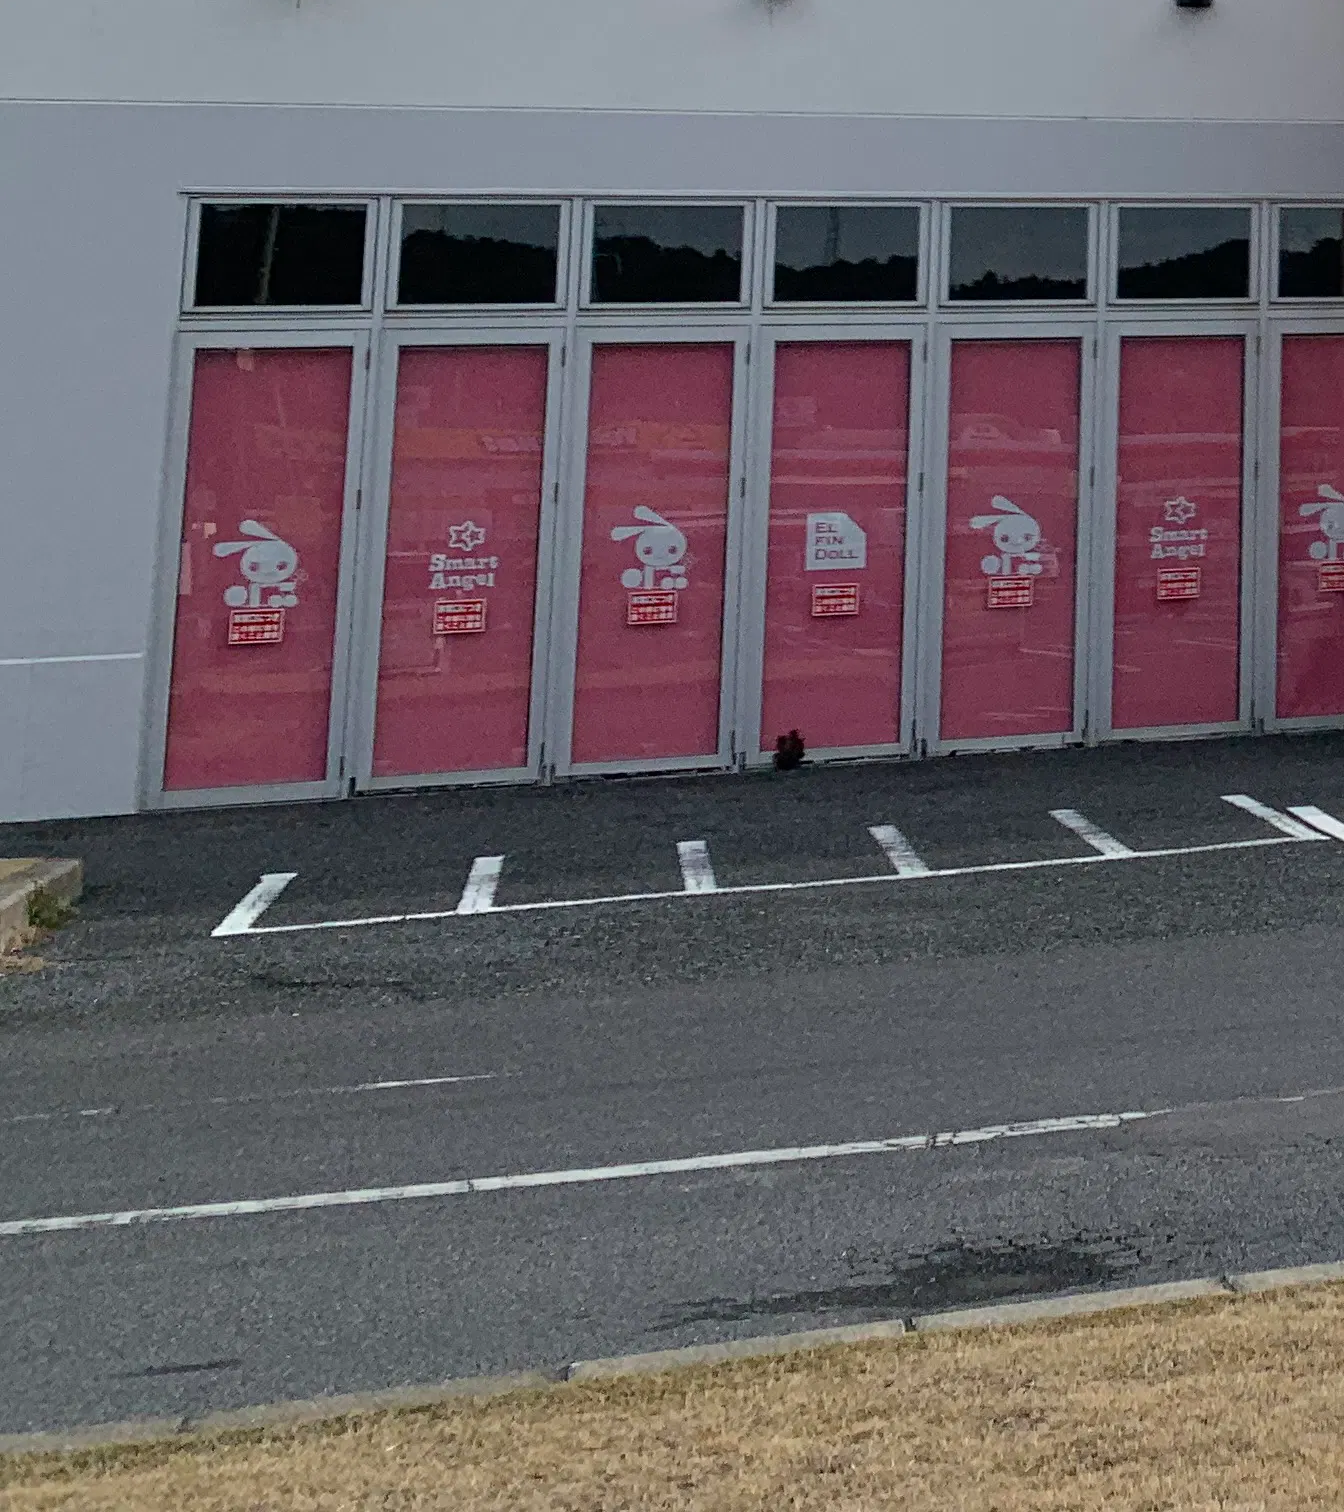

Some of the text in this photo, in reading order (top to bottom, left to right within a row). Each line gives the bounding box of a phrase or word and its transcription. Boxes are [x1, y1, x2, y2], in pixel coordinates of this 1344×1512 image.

[1149, 526, 1208, 543] Smart
[1150, 543, 1206, 561] Angel
[428, 554, 499, 571] Smart
[428, 572, 497, 591] Angel
